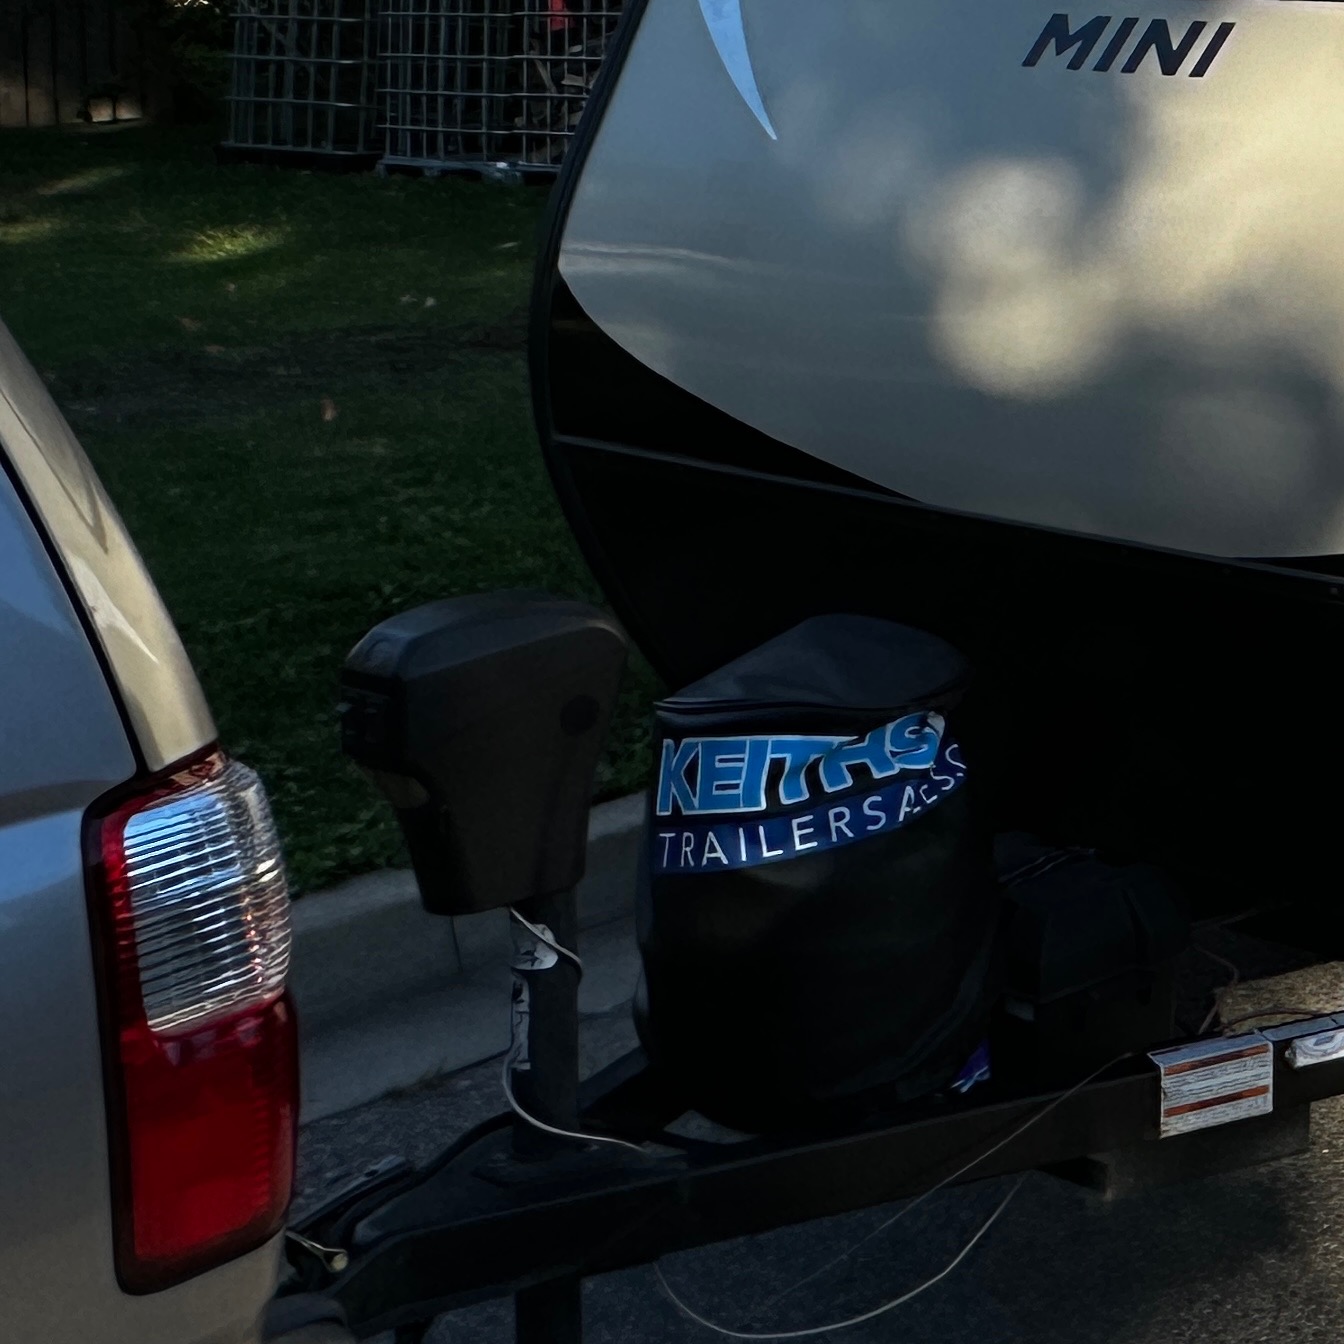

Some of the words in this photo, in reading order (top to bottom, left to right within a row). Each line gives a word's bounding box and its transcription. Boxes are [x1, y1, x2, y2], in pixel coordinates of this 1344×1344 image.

[1021, 13, 1236, 78] MINI
[656, 711, 946, 816] KEITHS
[659, 795, 887, 868] TRAILERS
